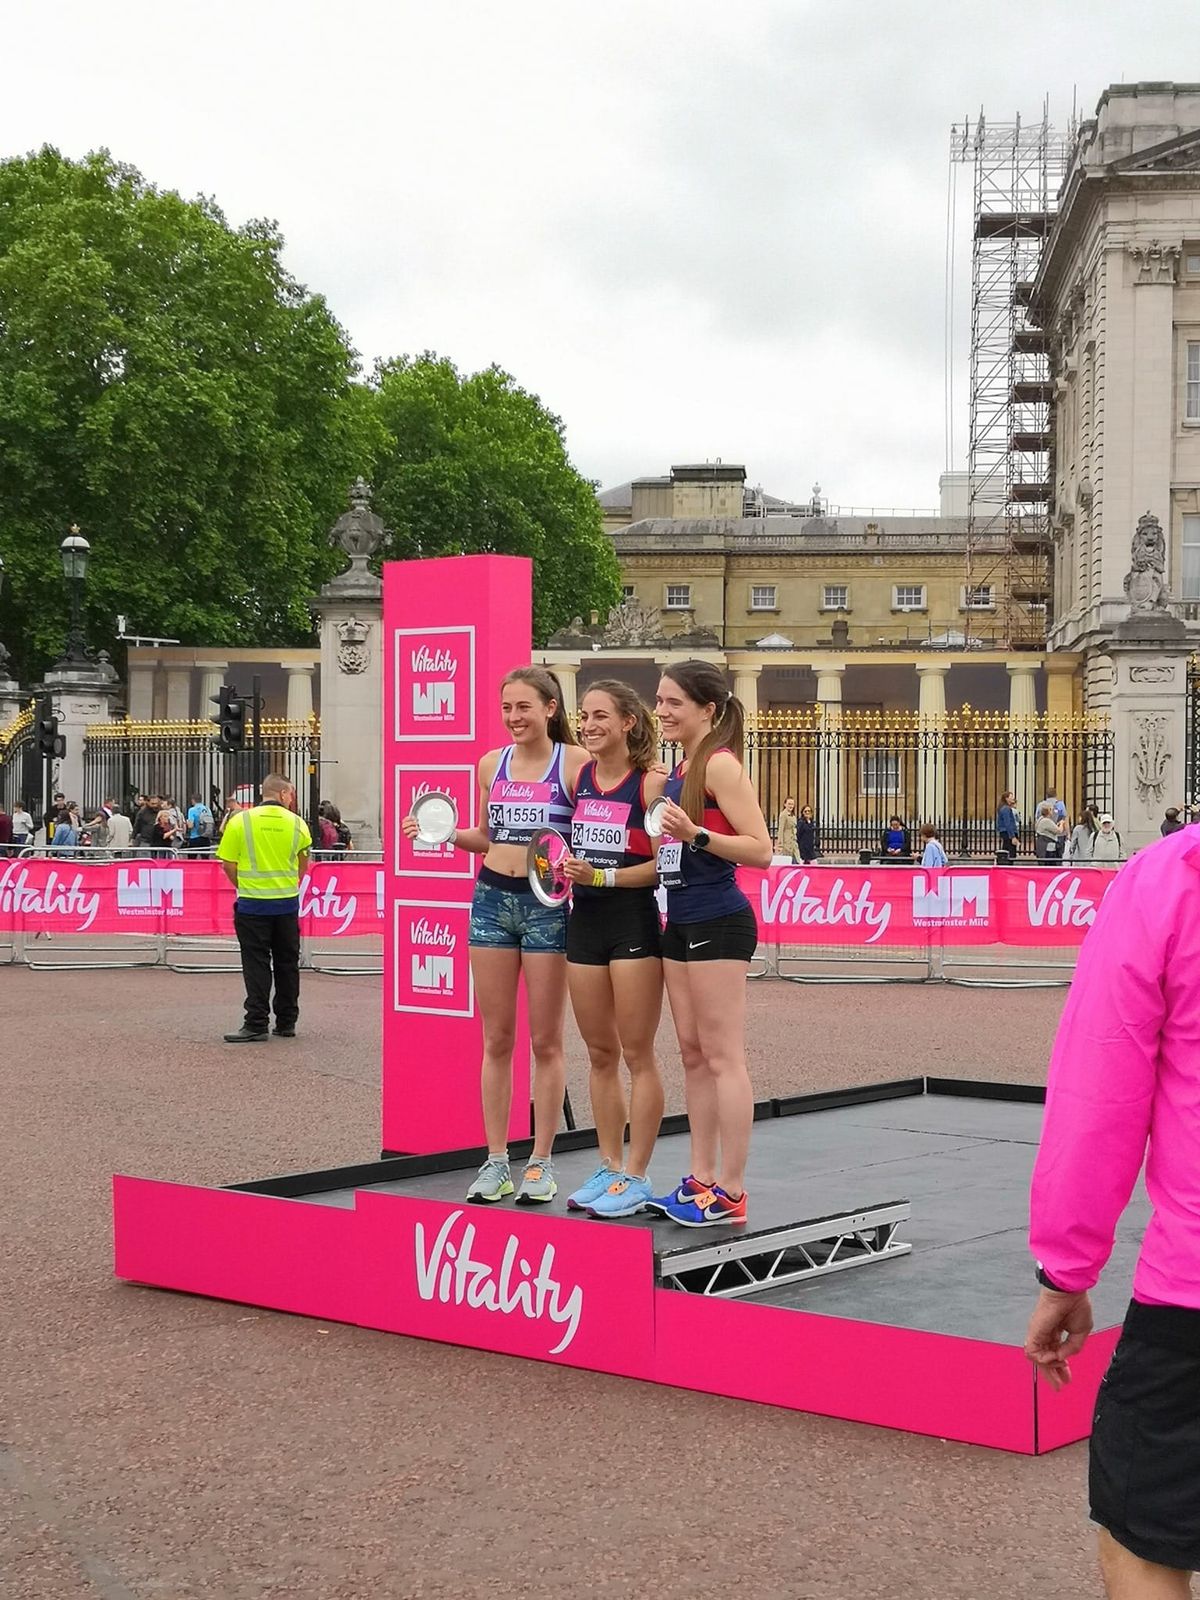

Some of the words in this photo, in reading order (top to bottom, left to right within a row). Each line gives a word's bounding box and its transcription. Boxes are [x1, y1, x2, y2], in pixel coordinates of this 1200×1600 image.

[411, 645, 457, 680] Vitality
[501, 783, 534, 801] Vitality
[491, 809, 504, 826] 24
[506, 808, 544, 822] 15551
[584, 800, 612, 821] Vitality
[573, 828, 583, 843] 24
[585, 827, 621, 844] 15560
[594, 857, 618, 866] balance
[299, 874, 357, 935] lity
[761, 869, 892, 943] Vitality
[1028, 871, 1097, 926] Vita
[118, 908, 165, 916] Westminster
[166, 908, 184, 916] Mile
[913, 918, 967, 927] Westminster
[969, 918, 989, 927] Mile
[411, 917, 456, 954] Vitality
[415, 1210, 583, 1354] Vitality
